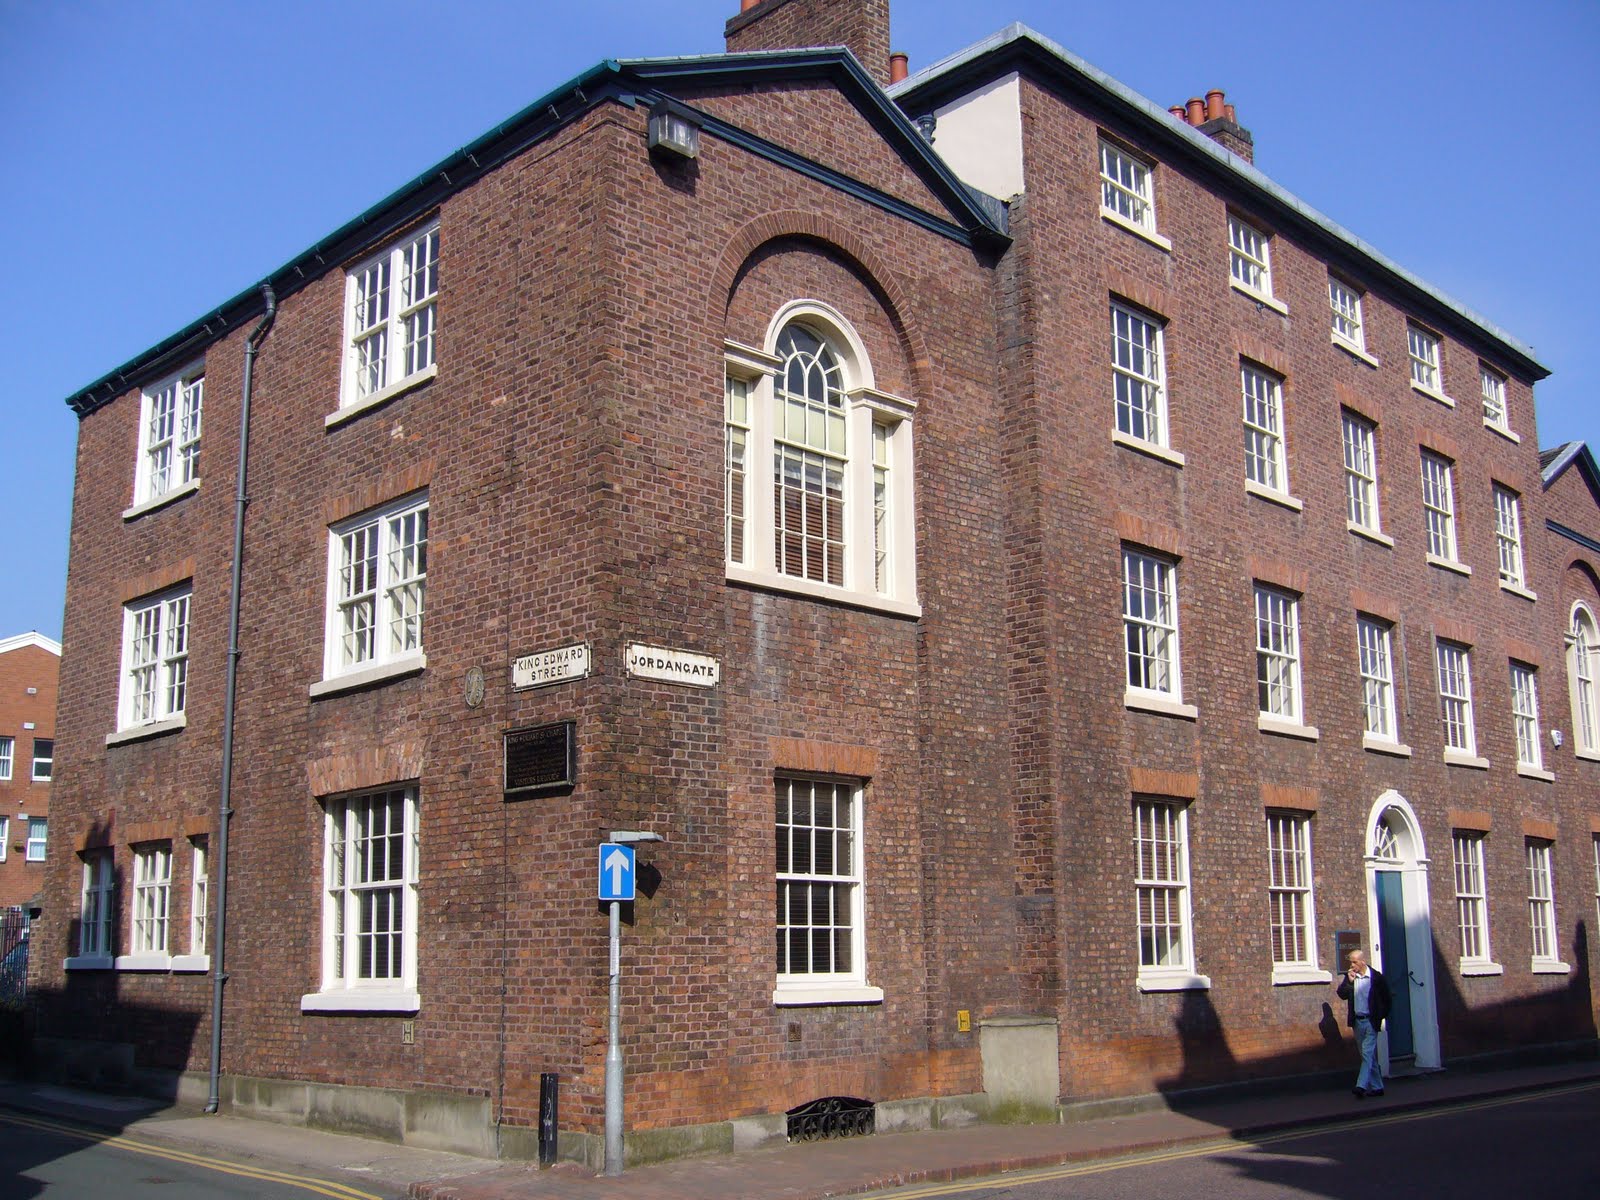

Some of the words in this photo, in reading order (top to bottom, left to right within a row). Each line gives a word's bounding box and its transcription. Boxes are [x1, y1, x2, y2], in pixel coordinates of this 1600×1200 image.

[518, 658, 540, 671] KING
[544, 648, 583, 665] EDWARD
[630, 655, 714, 677] JORDANGATE
[531, 664, 569, 681] STREET
